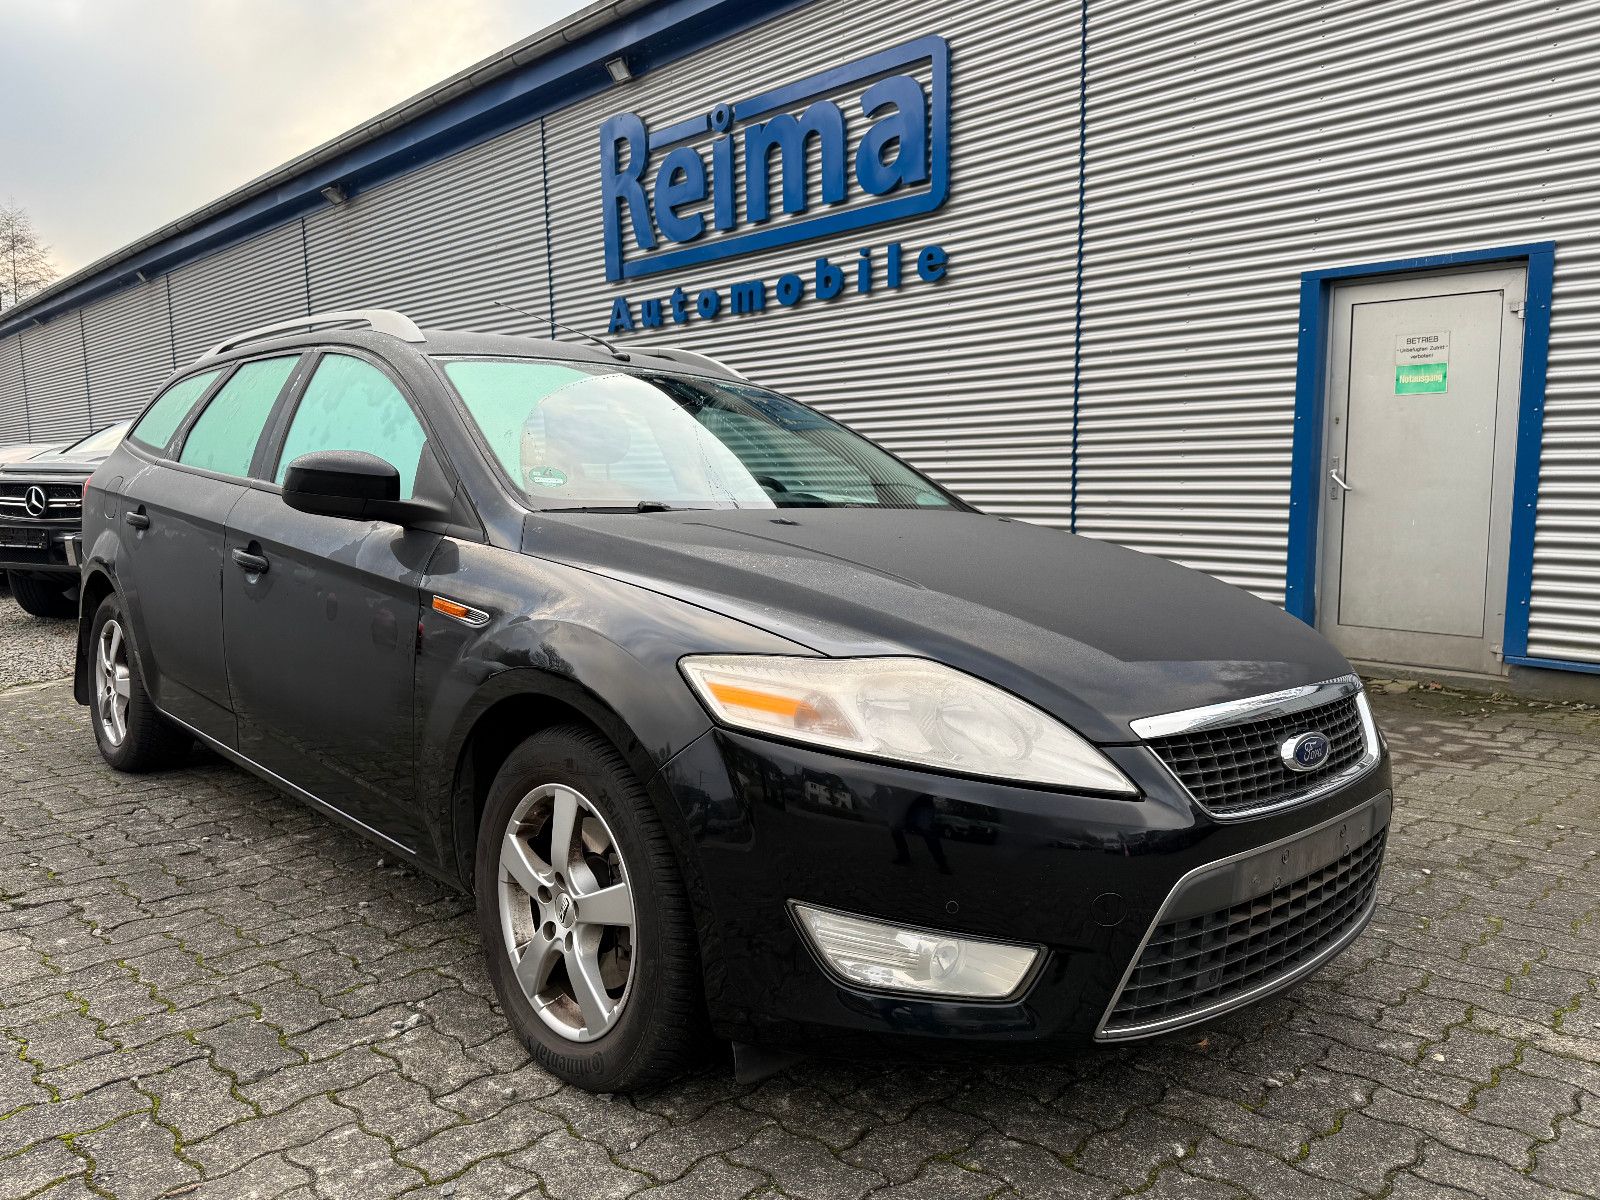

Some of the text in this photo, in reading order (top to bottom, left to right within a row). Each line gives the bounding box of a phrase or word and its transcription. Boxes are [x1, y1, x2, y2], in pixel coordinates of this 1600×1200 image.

[600, 75, 928, 282] Reima
[608, 243, 949, 333] Automobile
[1406, 335, 1439, 345] BETRIEB
[1399, 373, 1443, 384] Notausgang
[1303, 740, 1324, 762] Ford
